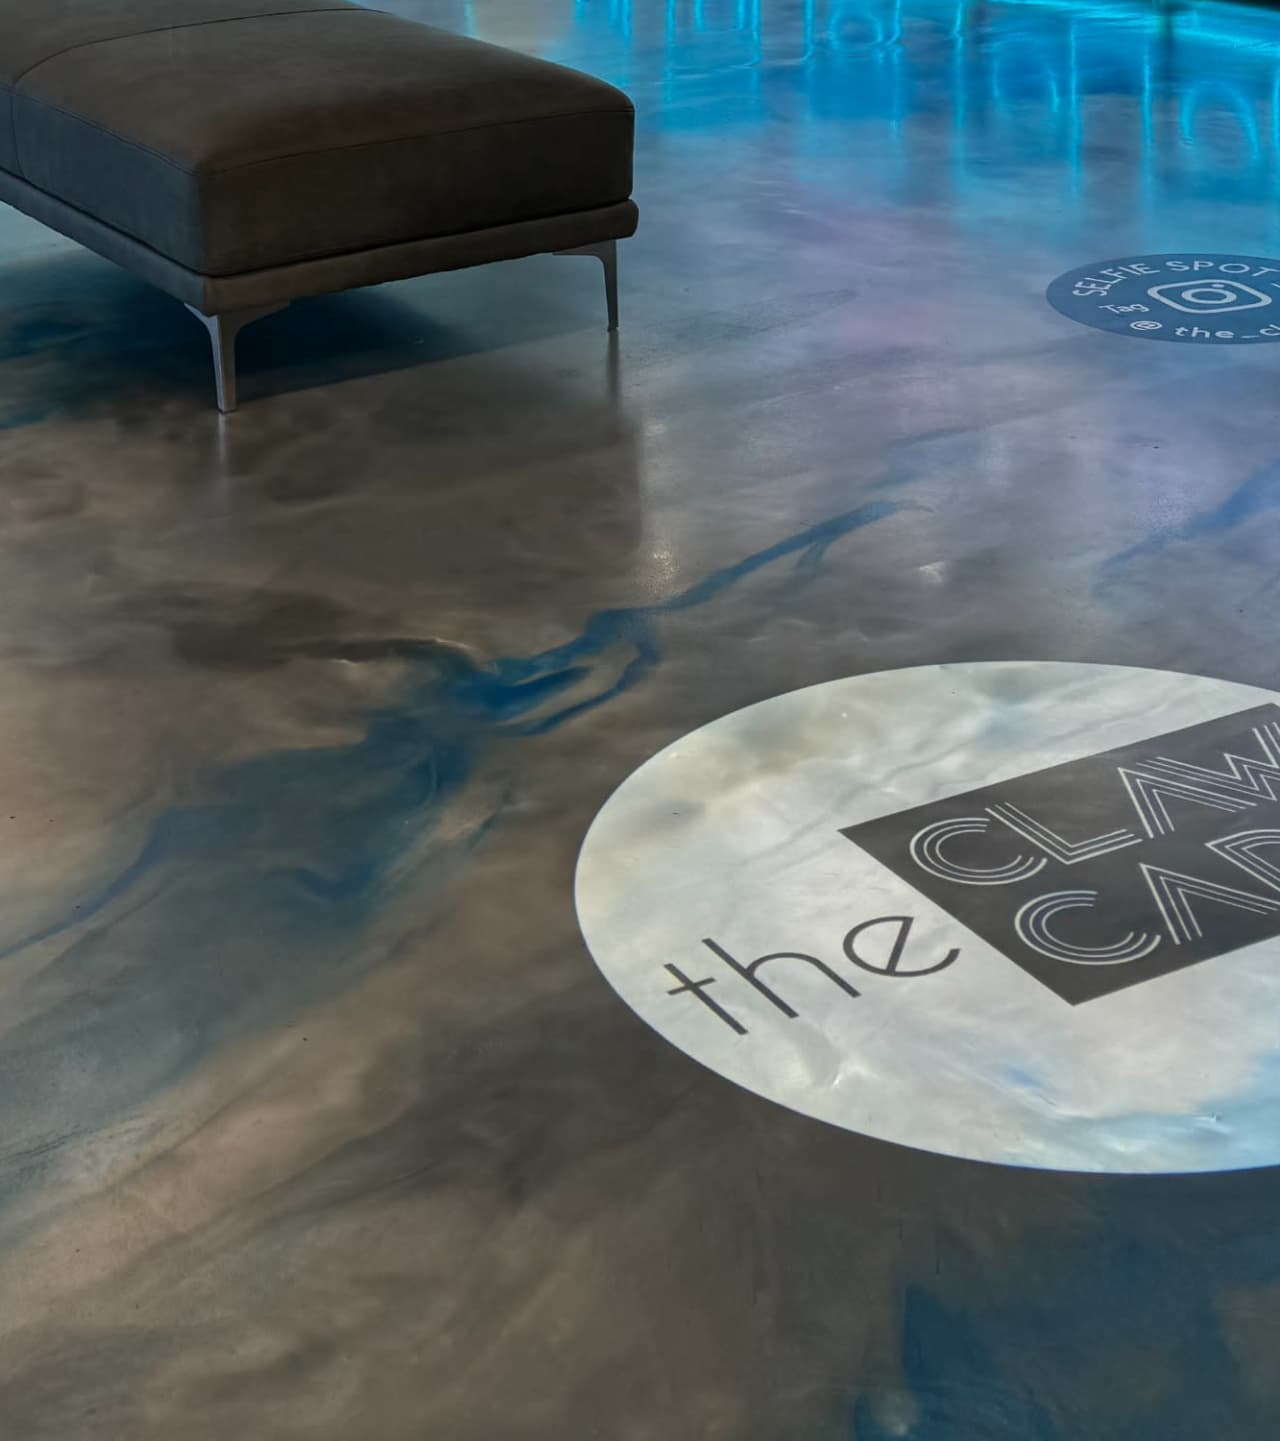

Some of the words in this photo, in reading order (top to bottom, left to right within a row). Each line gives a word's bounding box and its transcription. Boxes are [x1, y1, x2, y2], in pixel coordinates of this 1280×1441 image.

[1072, 263, 1160, 298] SELFIE
[1166, 260, 1280, 277] SPOT
[1099, 303, 1150, 316] Tag
[664, 915, 961, 1035] the
